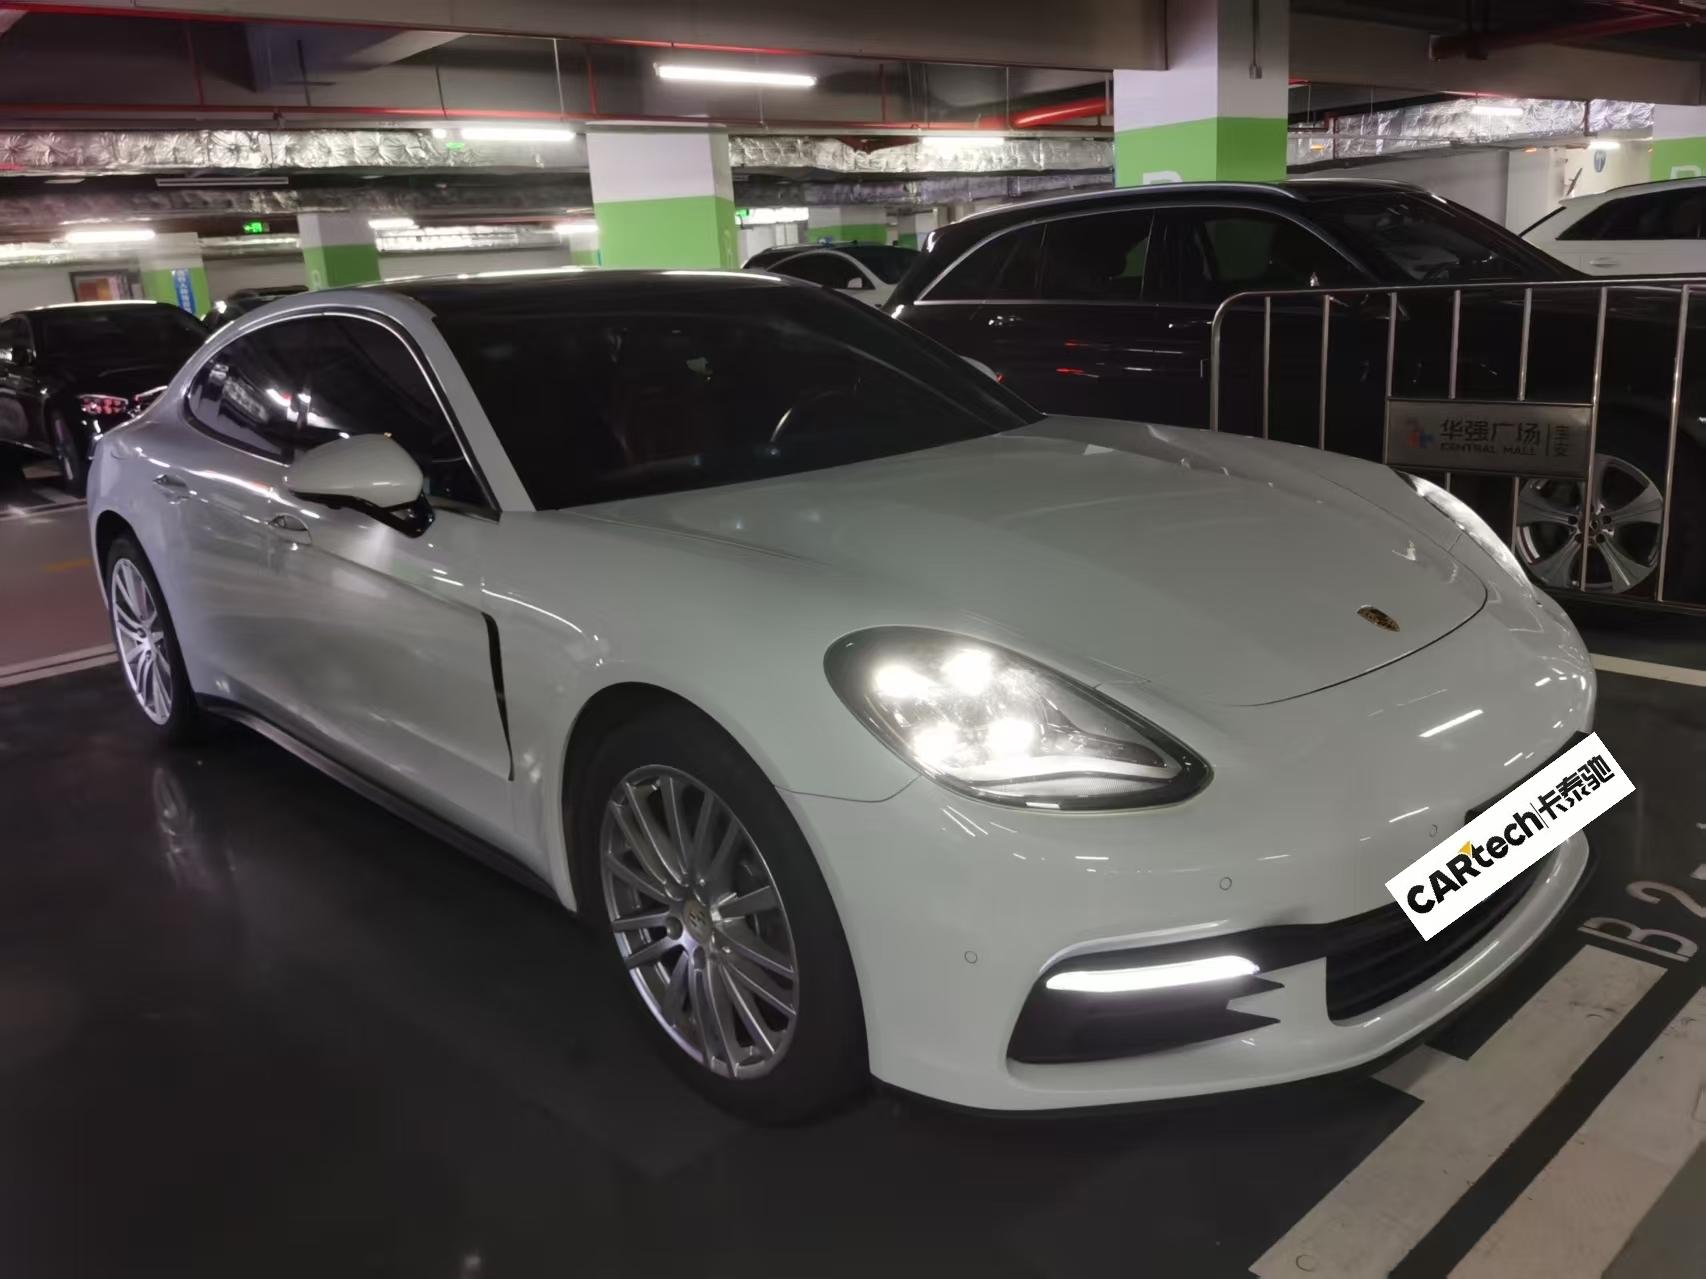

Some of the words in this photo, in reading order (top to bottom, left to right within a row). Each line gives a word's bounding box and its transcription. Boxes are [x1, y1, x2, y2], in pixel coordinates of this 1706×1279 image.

[1440, 419, 1541, 446] 华强广场
[1440, 442, 1496, 454] CENTRAL
[1503, 445, 1537, 456] MALL
[1579, 866, 1706, 962] B2
